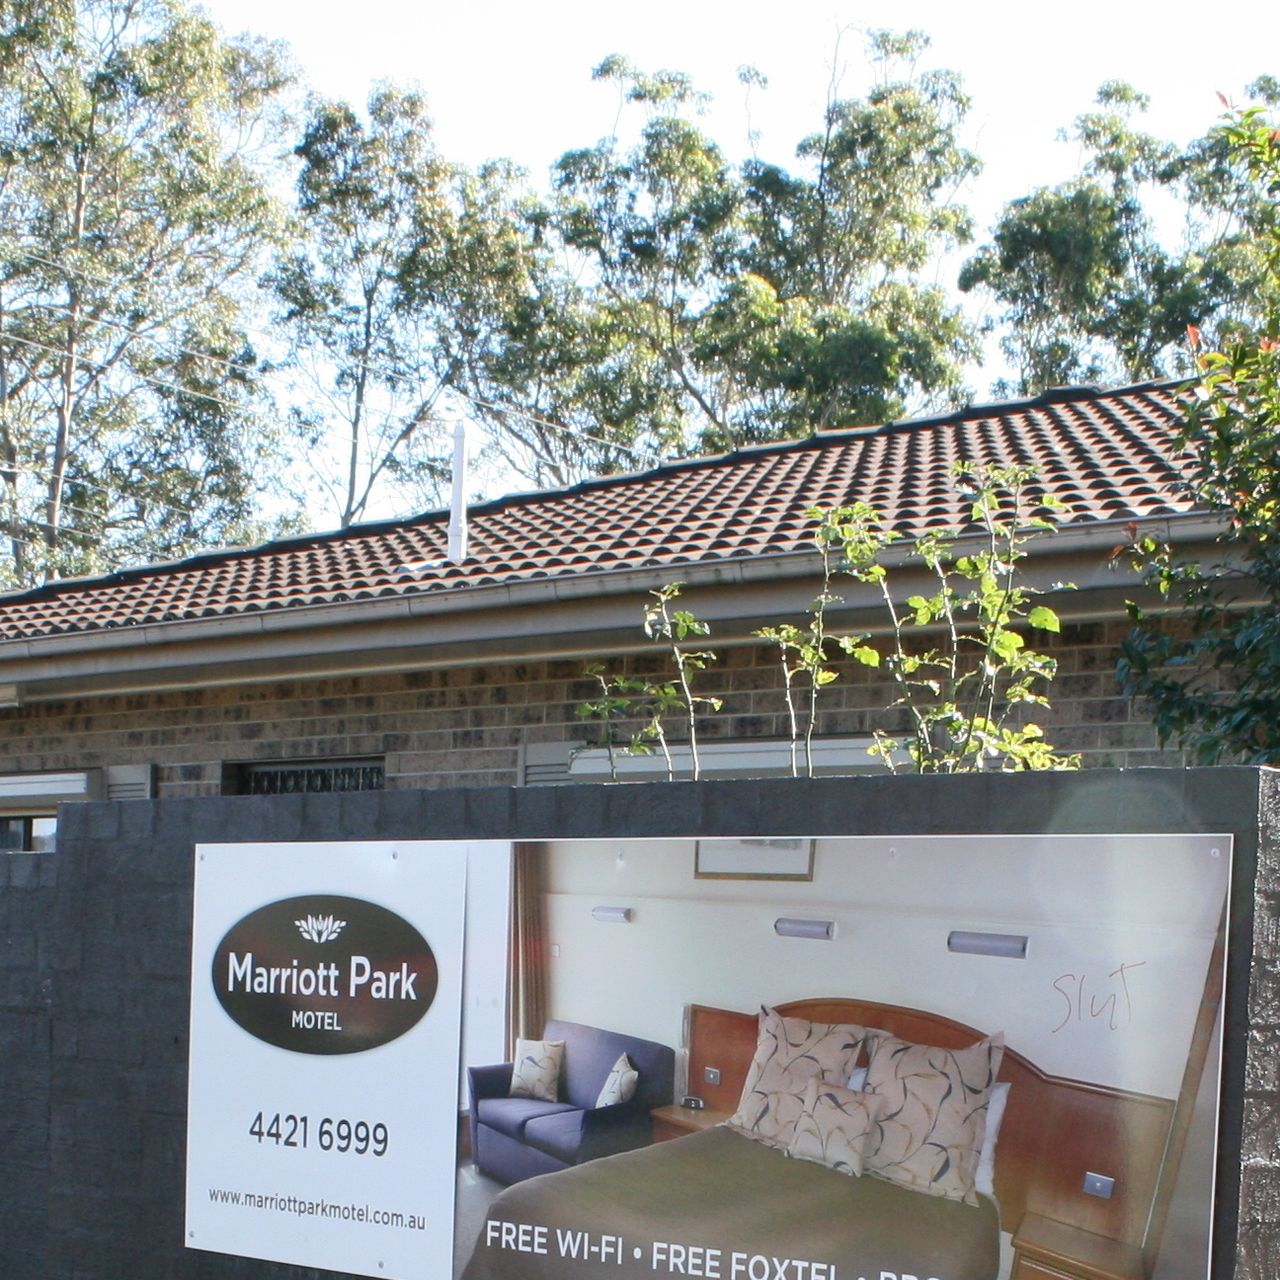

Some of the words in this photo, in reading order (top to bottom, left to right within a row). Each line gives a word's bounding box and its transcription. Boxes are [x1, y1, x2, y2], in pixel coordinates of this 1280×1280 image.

[228, 951, 340, 997] Marriott
[349, 955, 418, 1000] Park
[291, 1010, 342, 1031] MOTEL
[248, 1111, 309, 1149] 4421
[318, 1117, 389, 1157] 6999
[209, 1189, 426, 1230] www.marriottparkmotel.com.au
[486, 1220, 548, 1255] FREE
[556, 1228, 623, 1265] WI-FI
[652, 1241, 722, 1279] FREE
